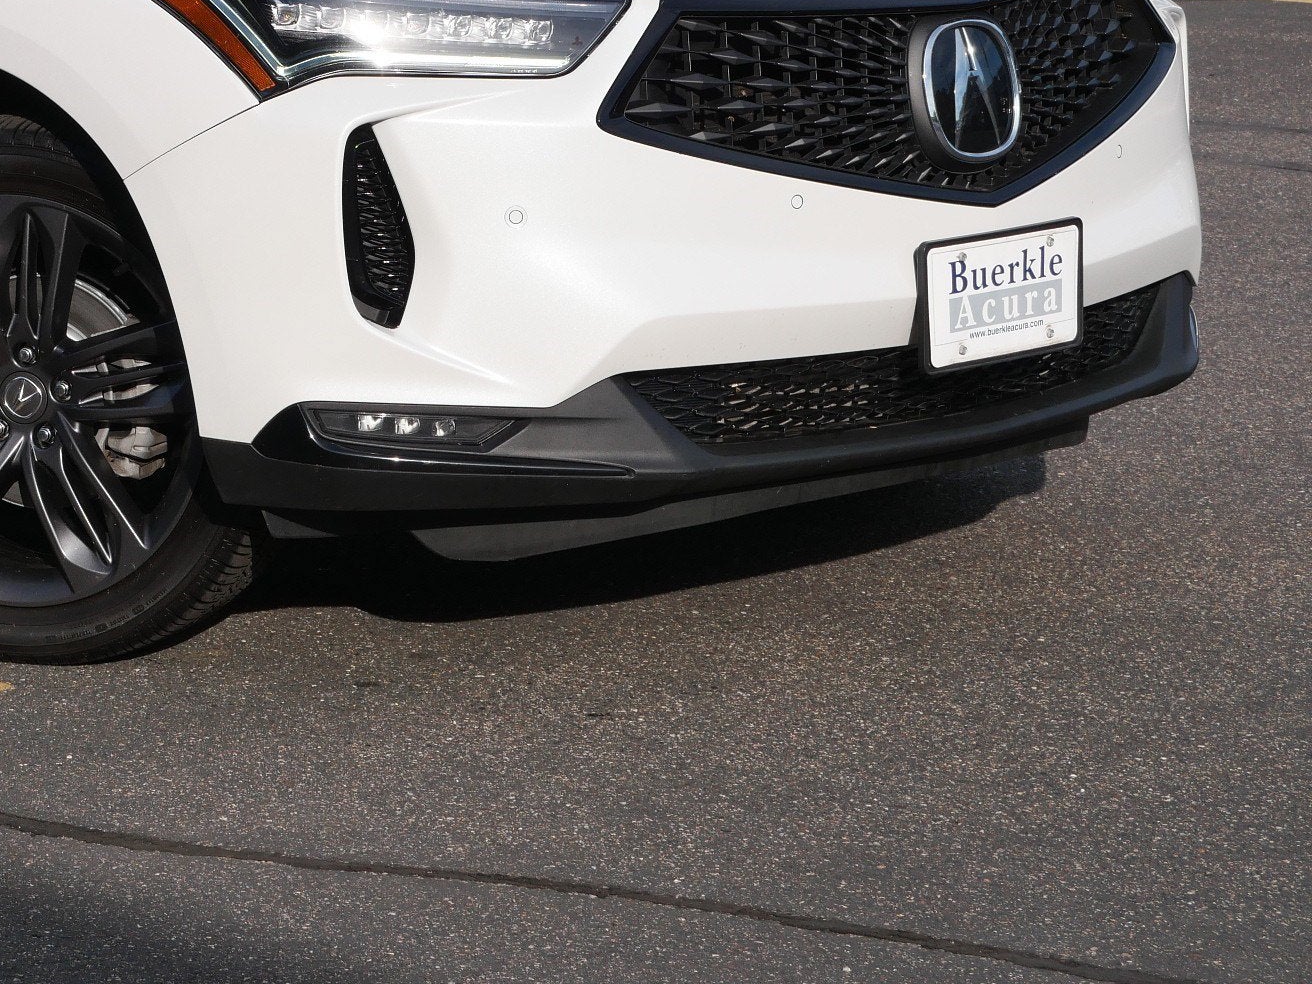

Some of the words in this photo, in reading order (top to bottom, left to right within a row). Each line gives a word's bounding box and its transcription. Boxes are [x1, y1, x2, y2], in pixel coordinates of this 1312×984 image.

[948, 245, 1063, 294] Buerkle
[954, 286, 1058, 329] Acura
[969, 319, 1044, 339] www.buerkleacura.com
